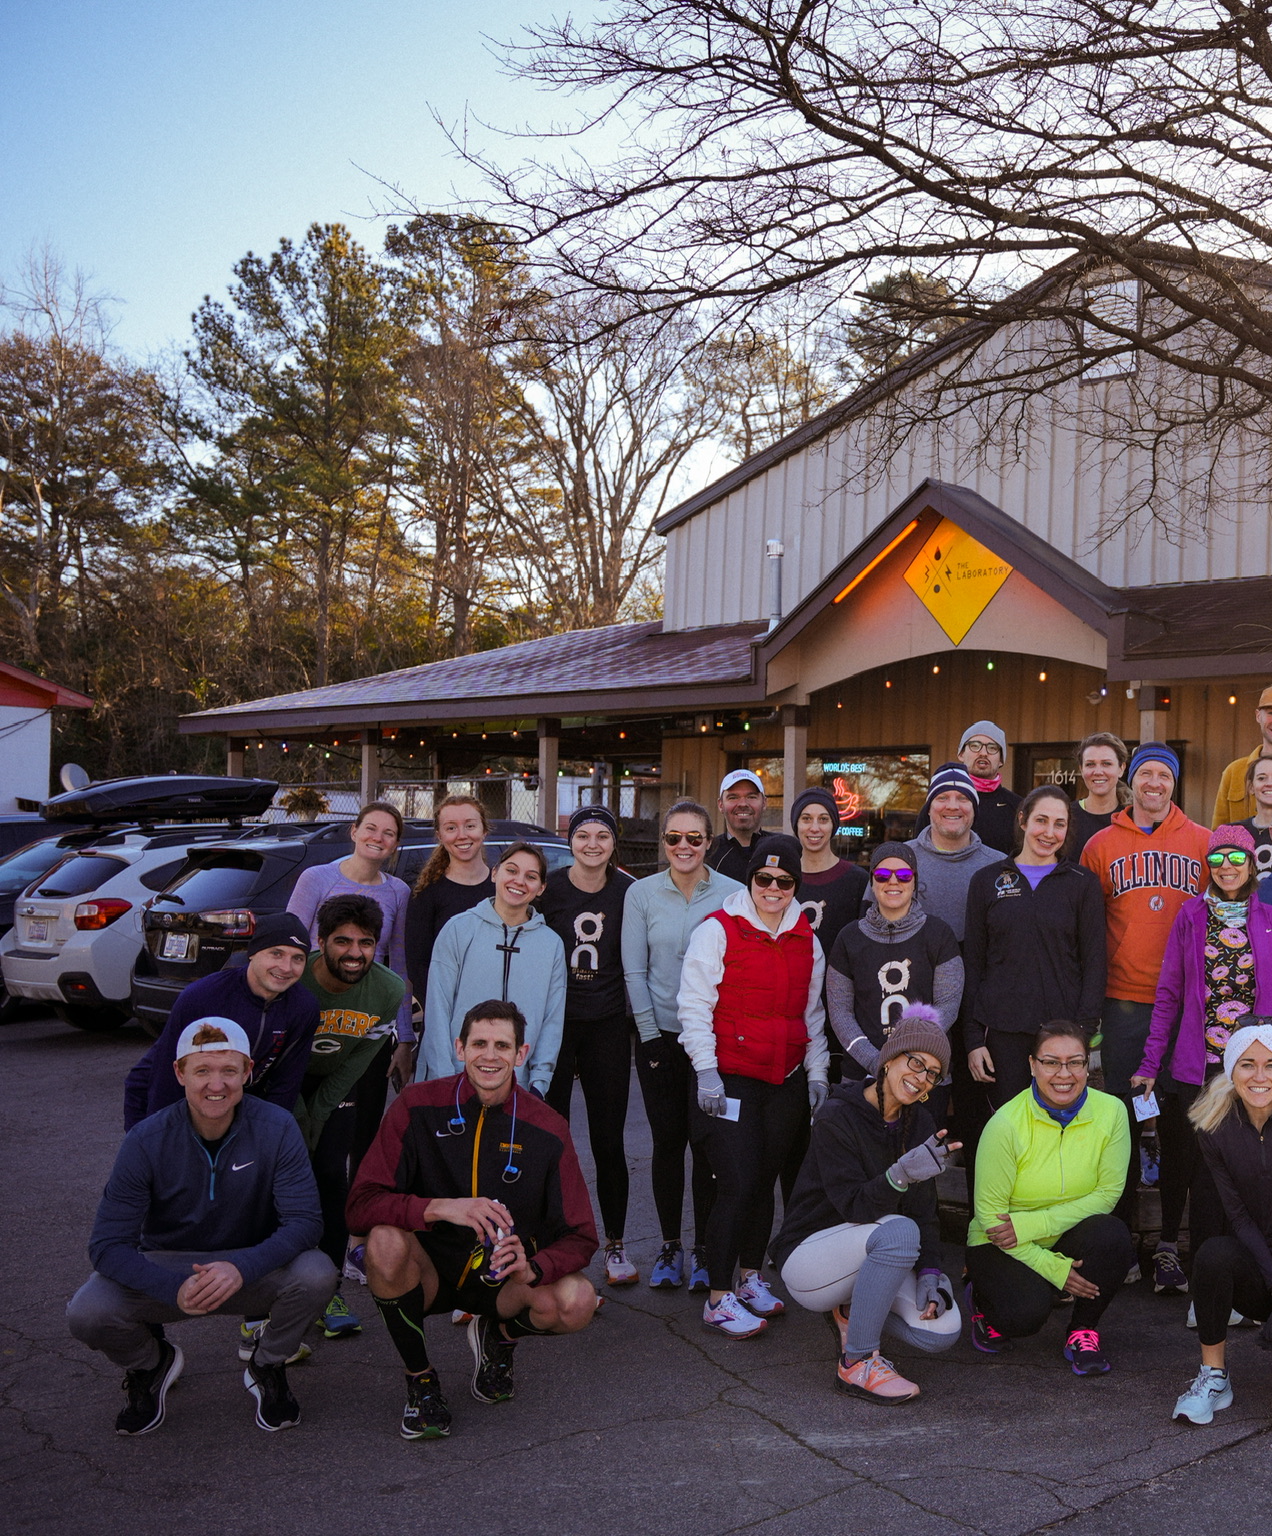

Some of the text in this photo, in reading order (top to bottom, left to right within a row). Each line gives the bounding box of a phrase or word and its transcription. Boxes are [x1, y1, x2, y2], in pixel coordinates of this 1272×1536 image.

[957, 562, 969, 570] THE
[956, 566, 1009, 581] LABORATORY
[823, 762, 867, 773] WORLD'S BEST
[1050, 769, 1076, 785] 1614
[842, 827, 864, 837] COFFEE
[1109, 850, 1202, 898] ILLINOIS
